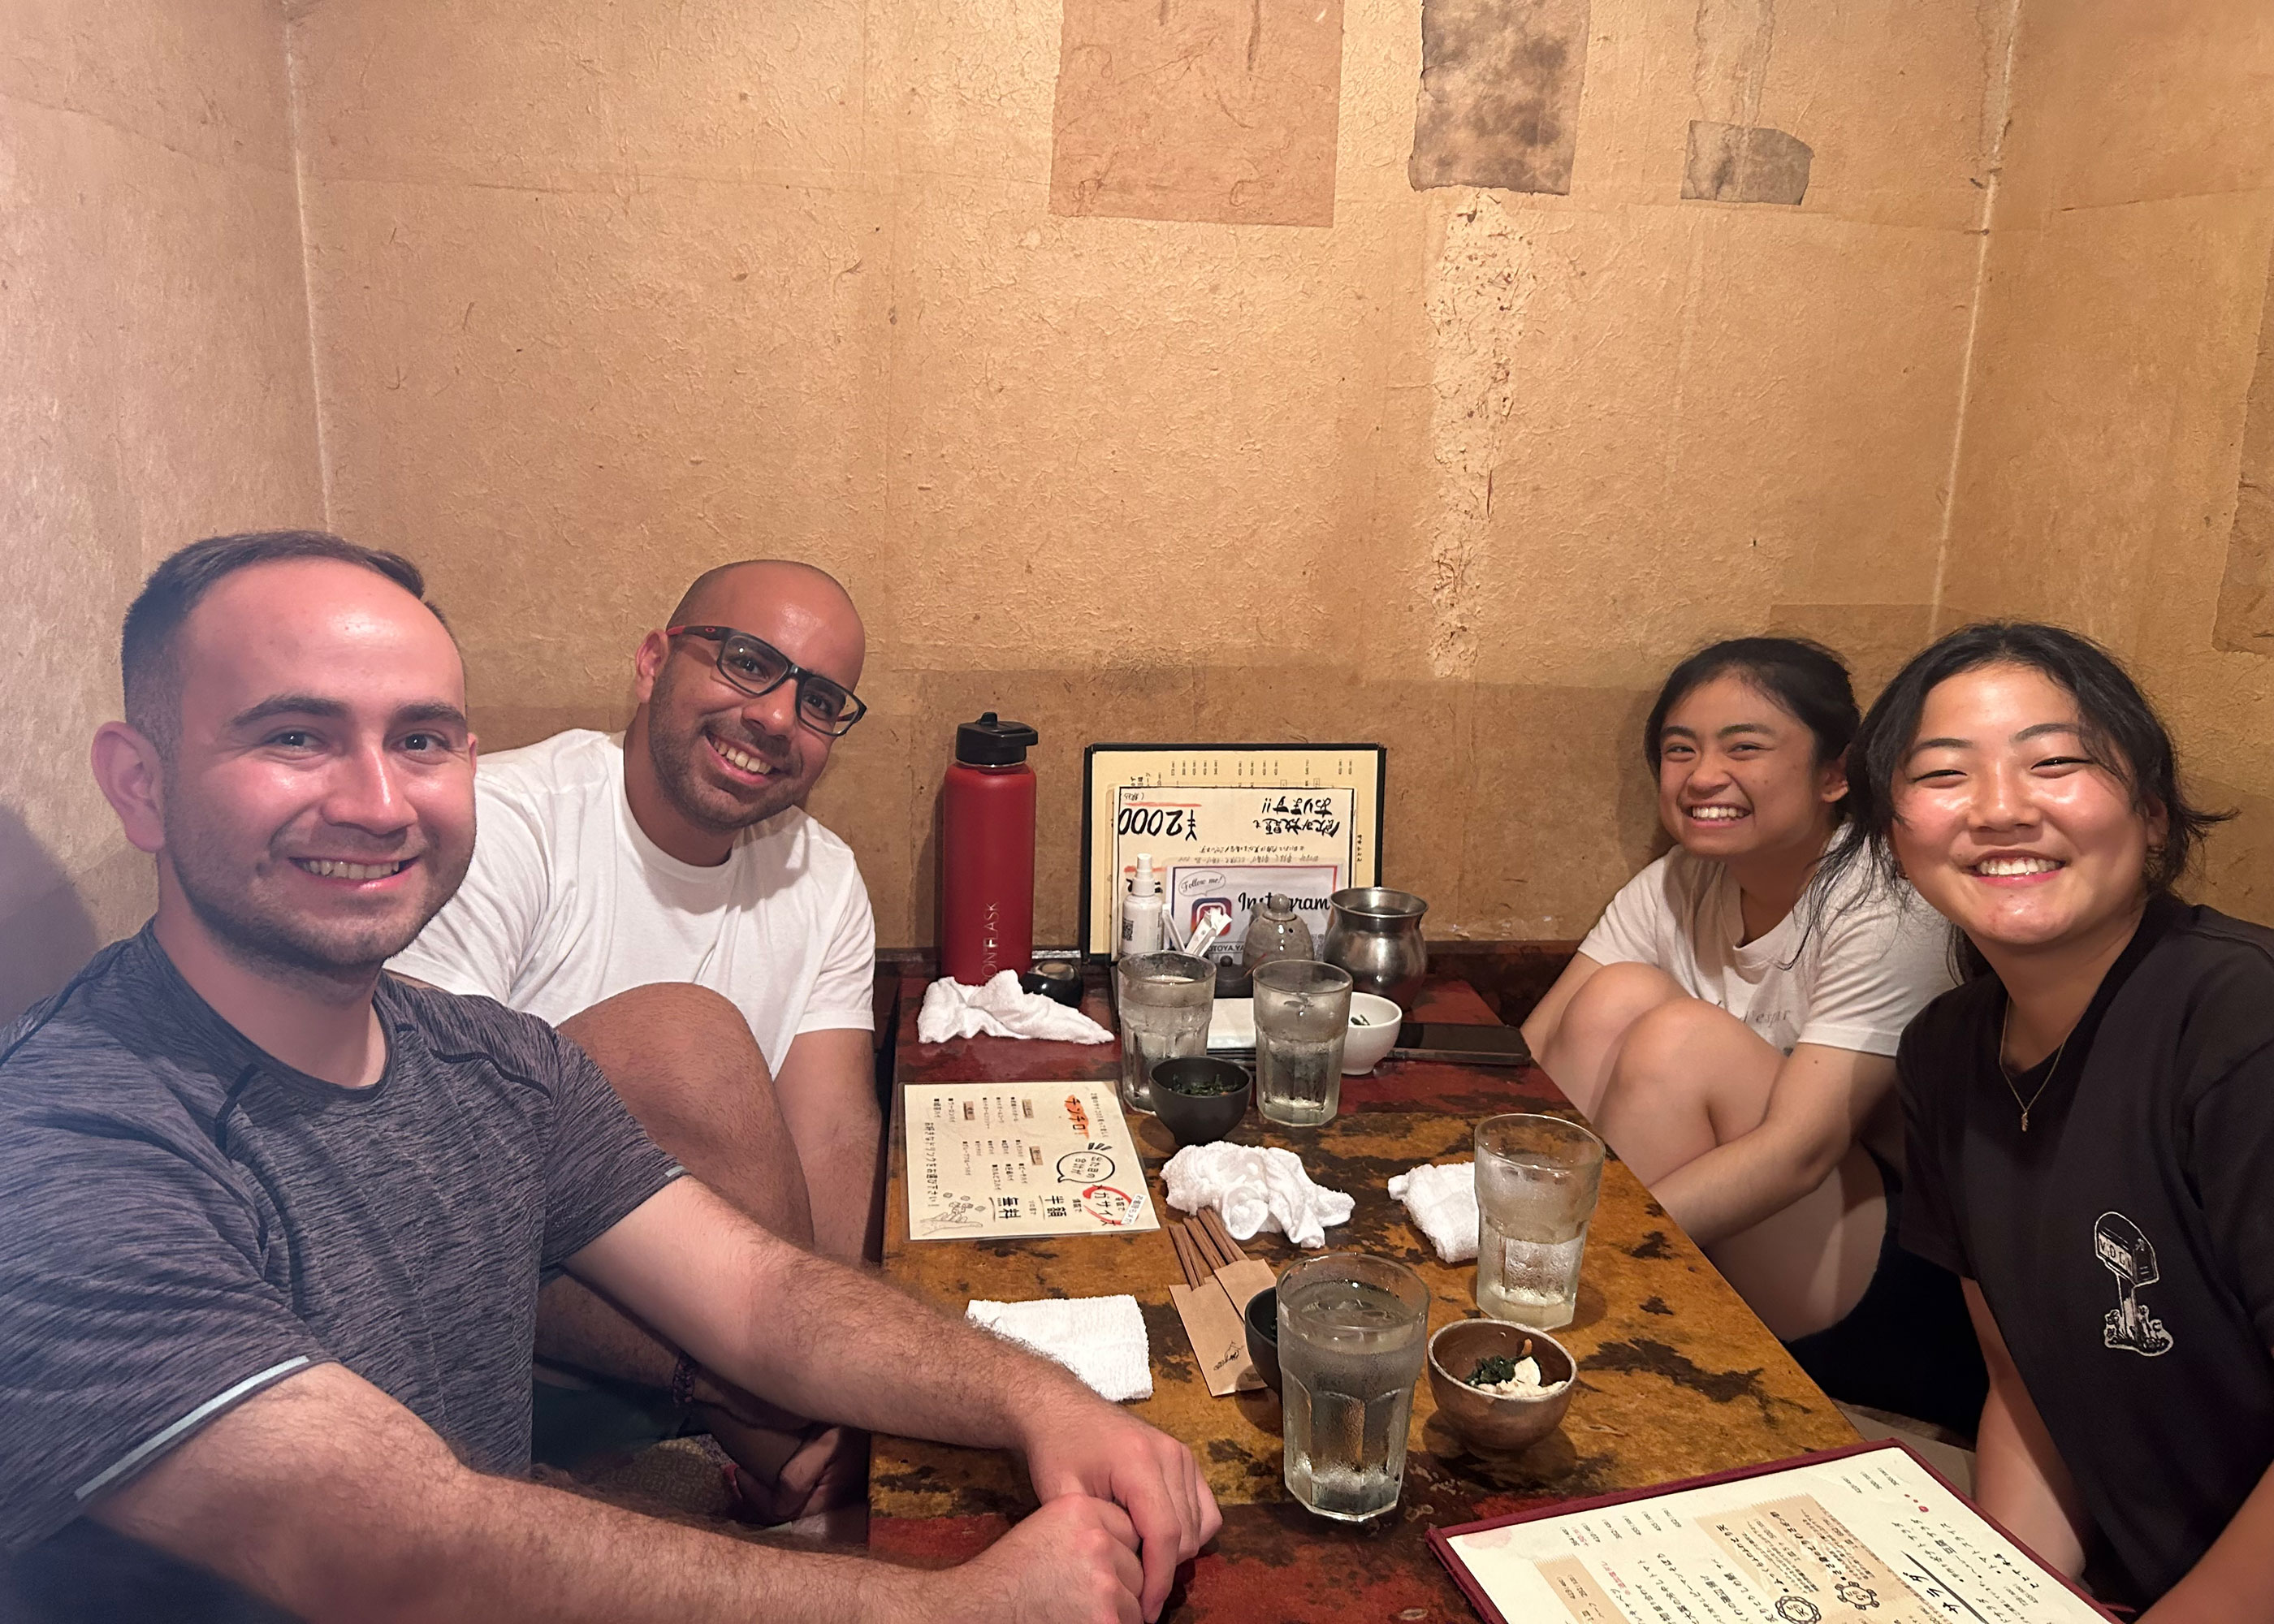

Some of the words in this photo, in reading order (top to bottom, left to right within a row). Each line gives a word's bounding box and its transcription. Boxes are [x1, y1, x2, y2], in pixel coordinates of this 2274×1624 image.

[1118, 808, 1198, 840] ¥2000
[1180, 878, 1205, 892] Follow
[1208, 875, 1222, 884] me!
[997, 1196, 1022, 1219] 無料
[1044, 1196, 1067, 1217] 半額
[1936, 1522, 1998, 1569] トマトスライス
[1901, 1568, 1965, 1616] サラダ
